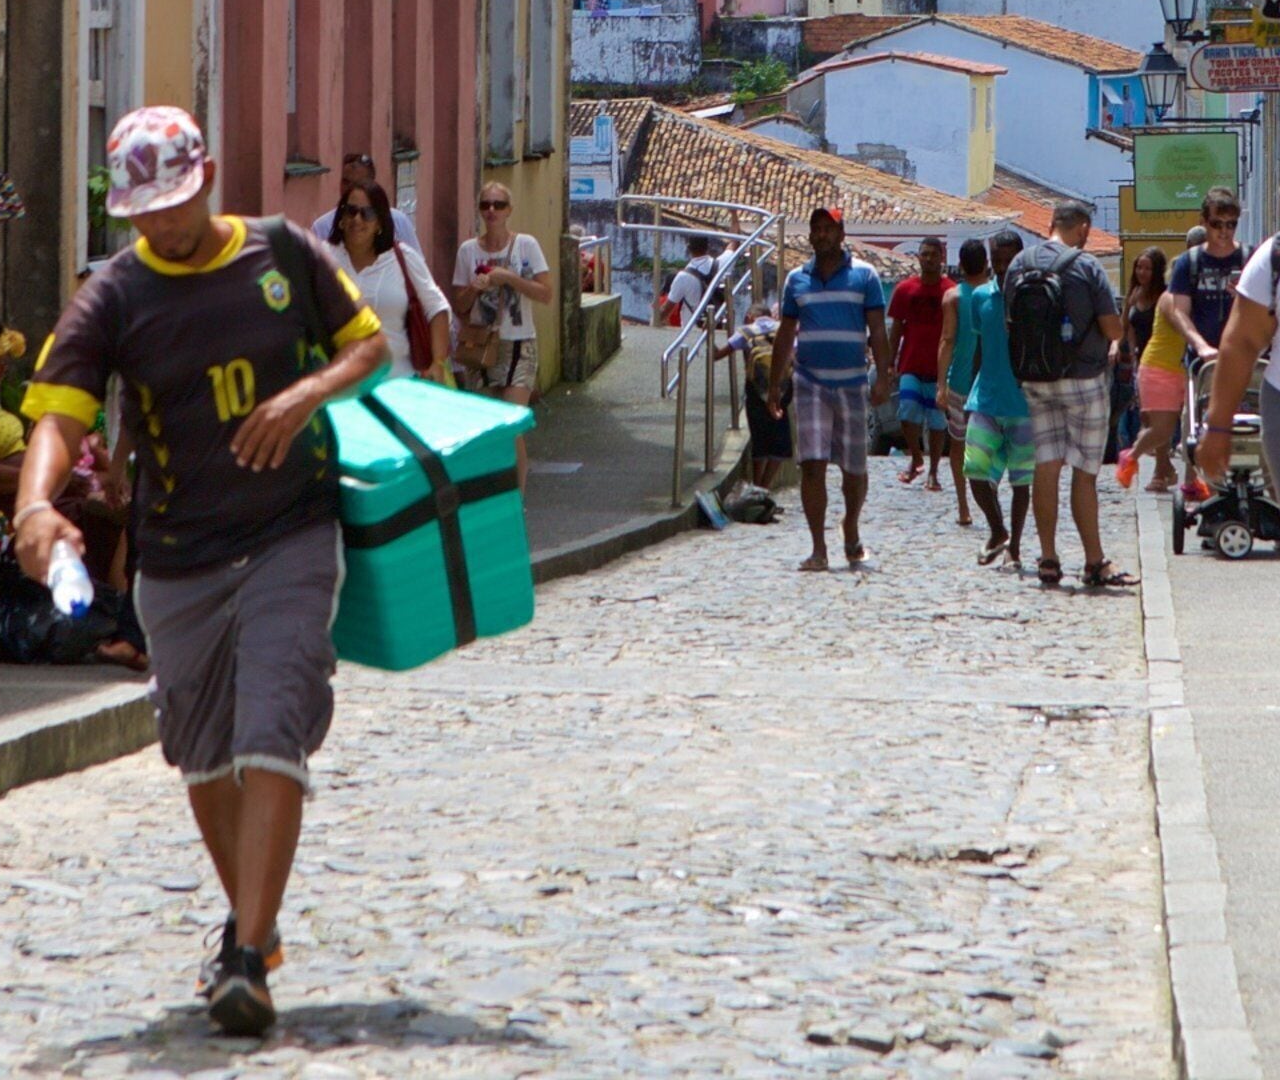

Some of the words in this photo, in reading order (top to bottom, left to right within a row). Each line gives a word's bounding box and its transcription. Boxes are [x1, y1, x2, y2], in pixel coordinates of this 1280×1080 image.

[1203, 48, 1230, 59] BAHIA
[1233, 46, 1265, 58] TICKET
[1210, 59, 1234, 68] TOUR
[1208, 68, 1251, 77] PACOTES
[1210, 76, 1265, 86] PASSAGENS
[206, 358, 255, 421] 10
